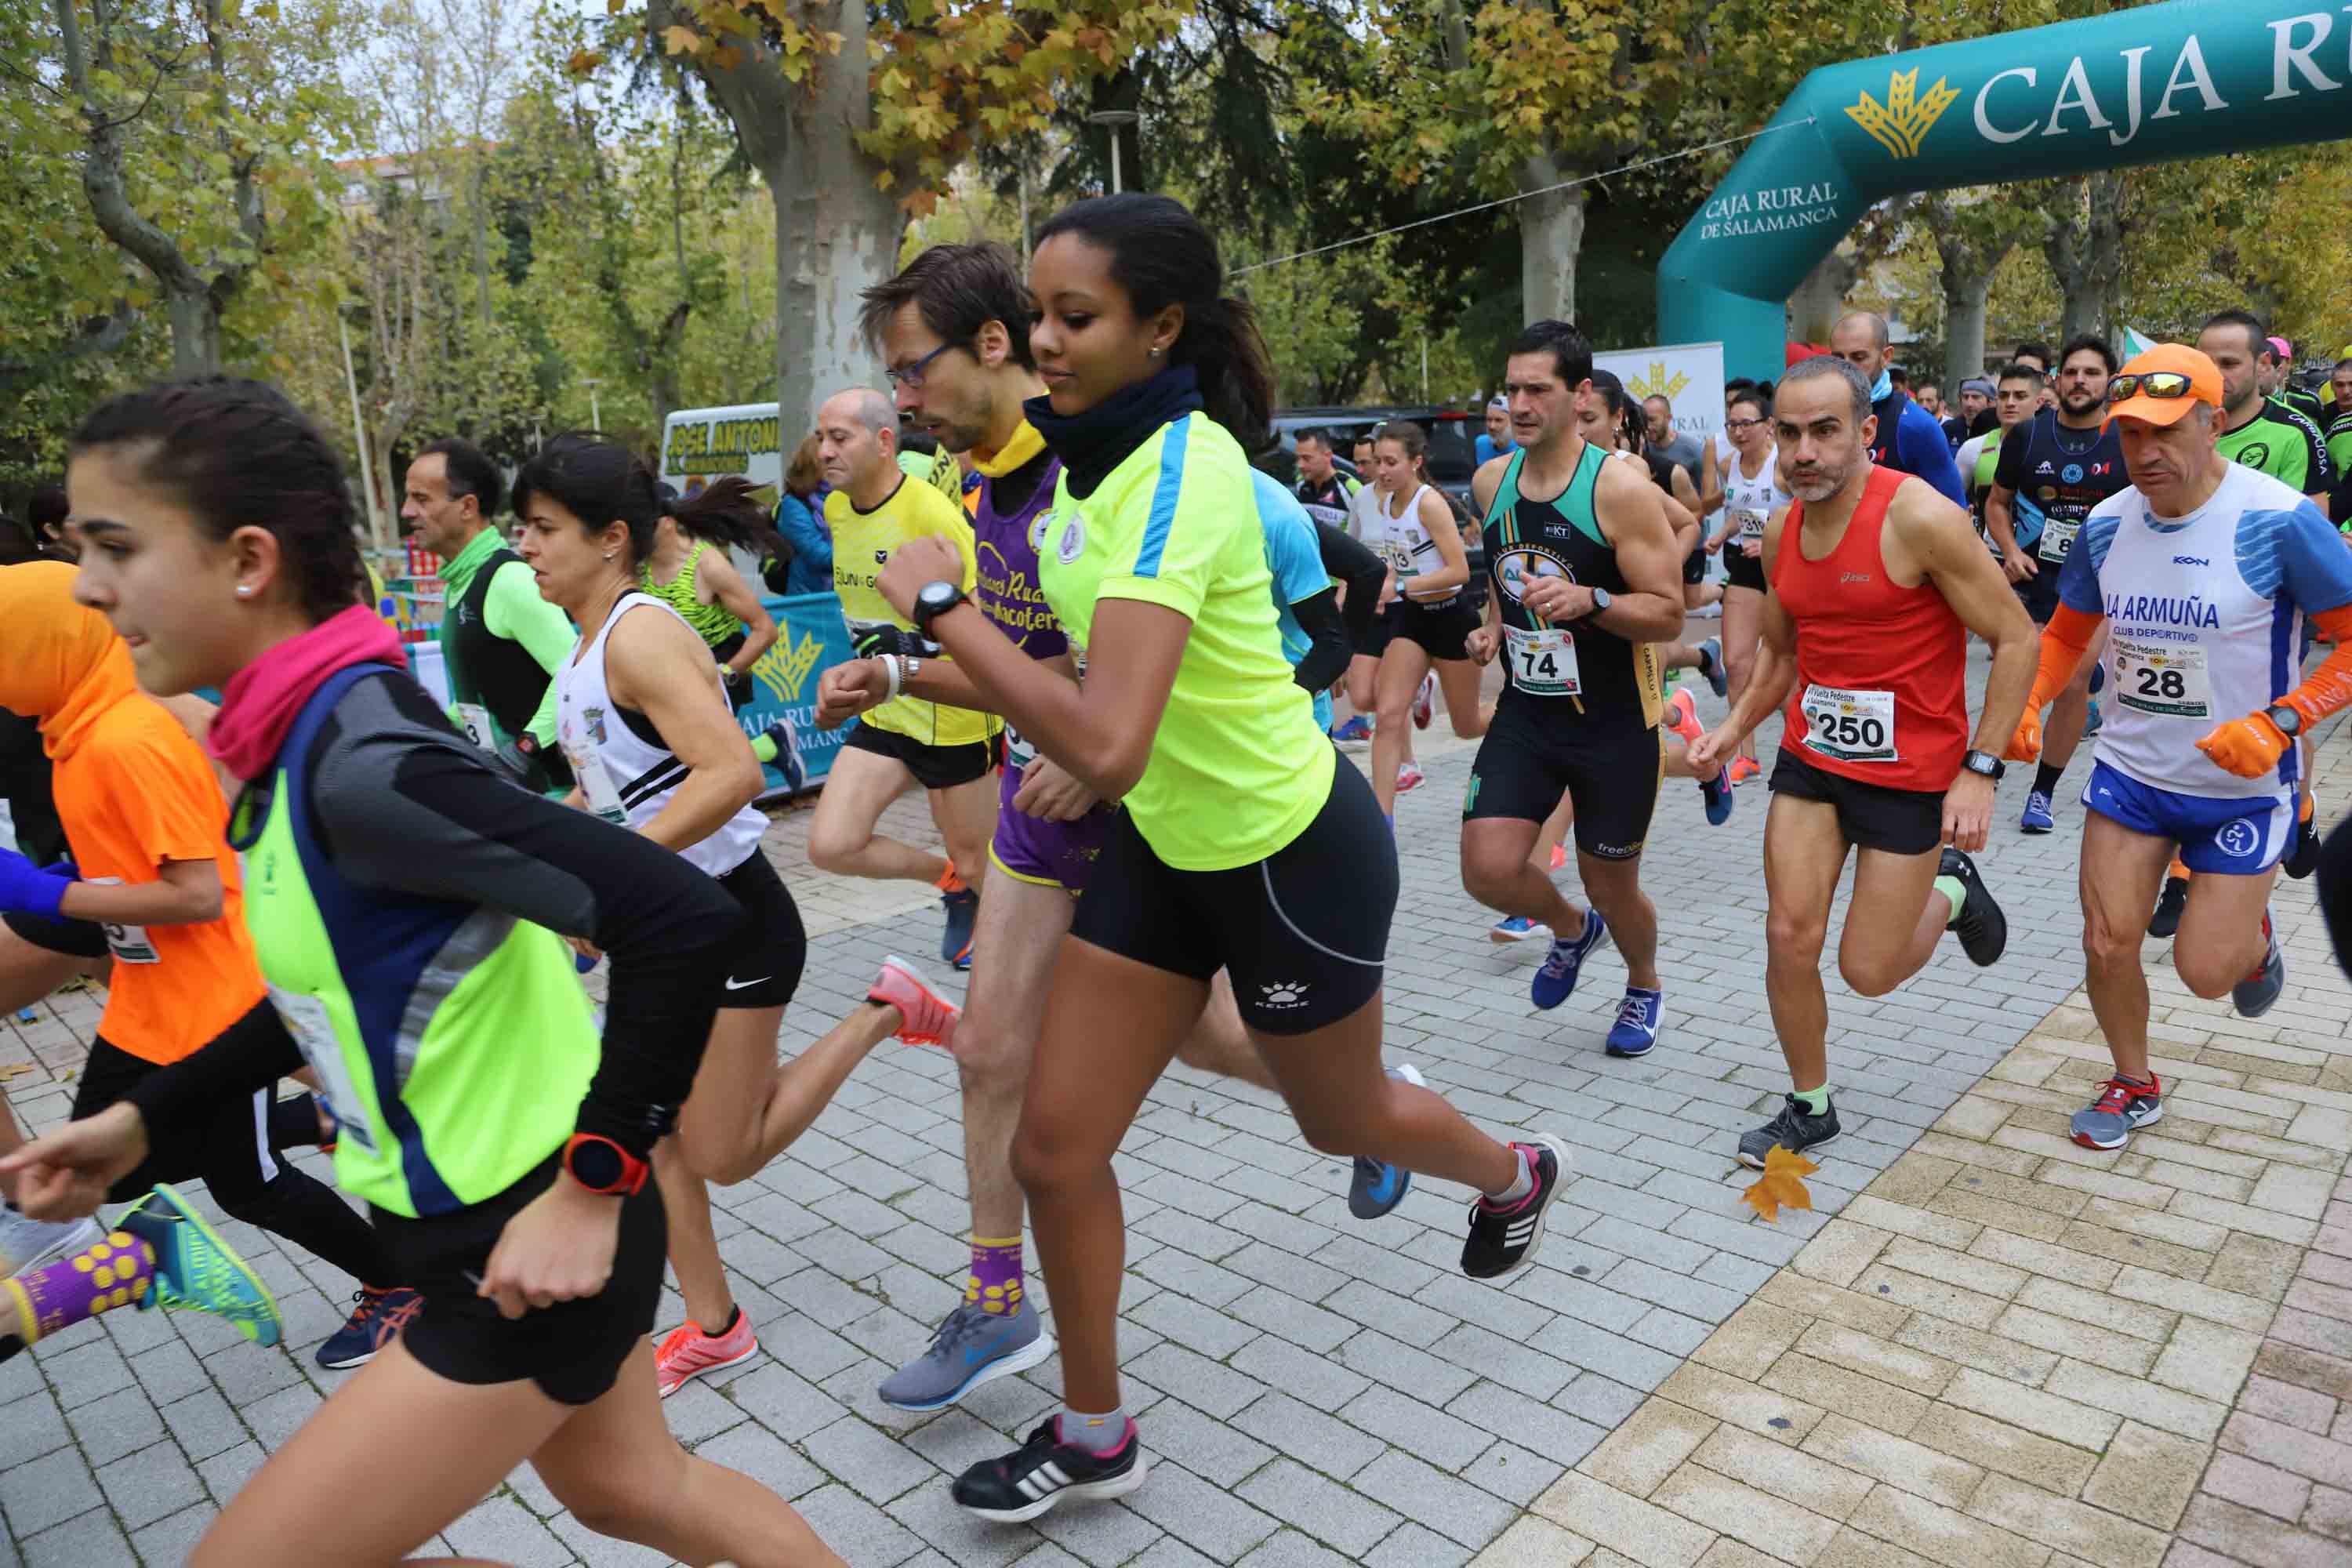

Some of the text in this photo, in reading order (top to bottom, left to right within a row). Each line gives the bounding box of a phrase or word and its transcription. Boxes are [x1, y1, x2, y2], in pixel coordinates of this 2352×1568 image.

[1973, 34, 2230, 147] CAJA
[1705, 182, 1838, 220] CAJA RURAL
[1700, 206, 1838, 239] DE SALAMANCA
[2106, 593, 2220, 630] LA ARMUÑA
[2114, 626, 2198, 643] CLUB DEPORTIVO
[2137, 643, 2167, 655] Pedestre
[1521, 652, 1559, 678] 74
[2136, 667, 2185, 699] 28
[1818, 713, 1885, 748] 250
